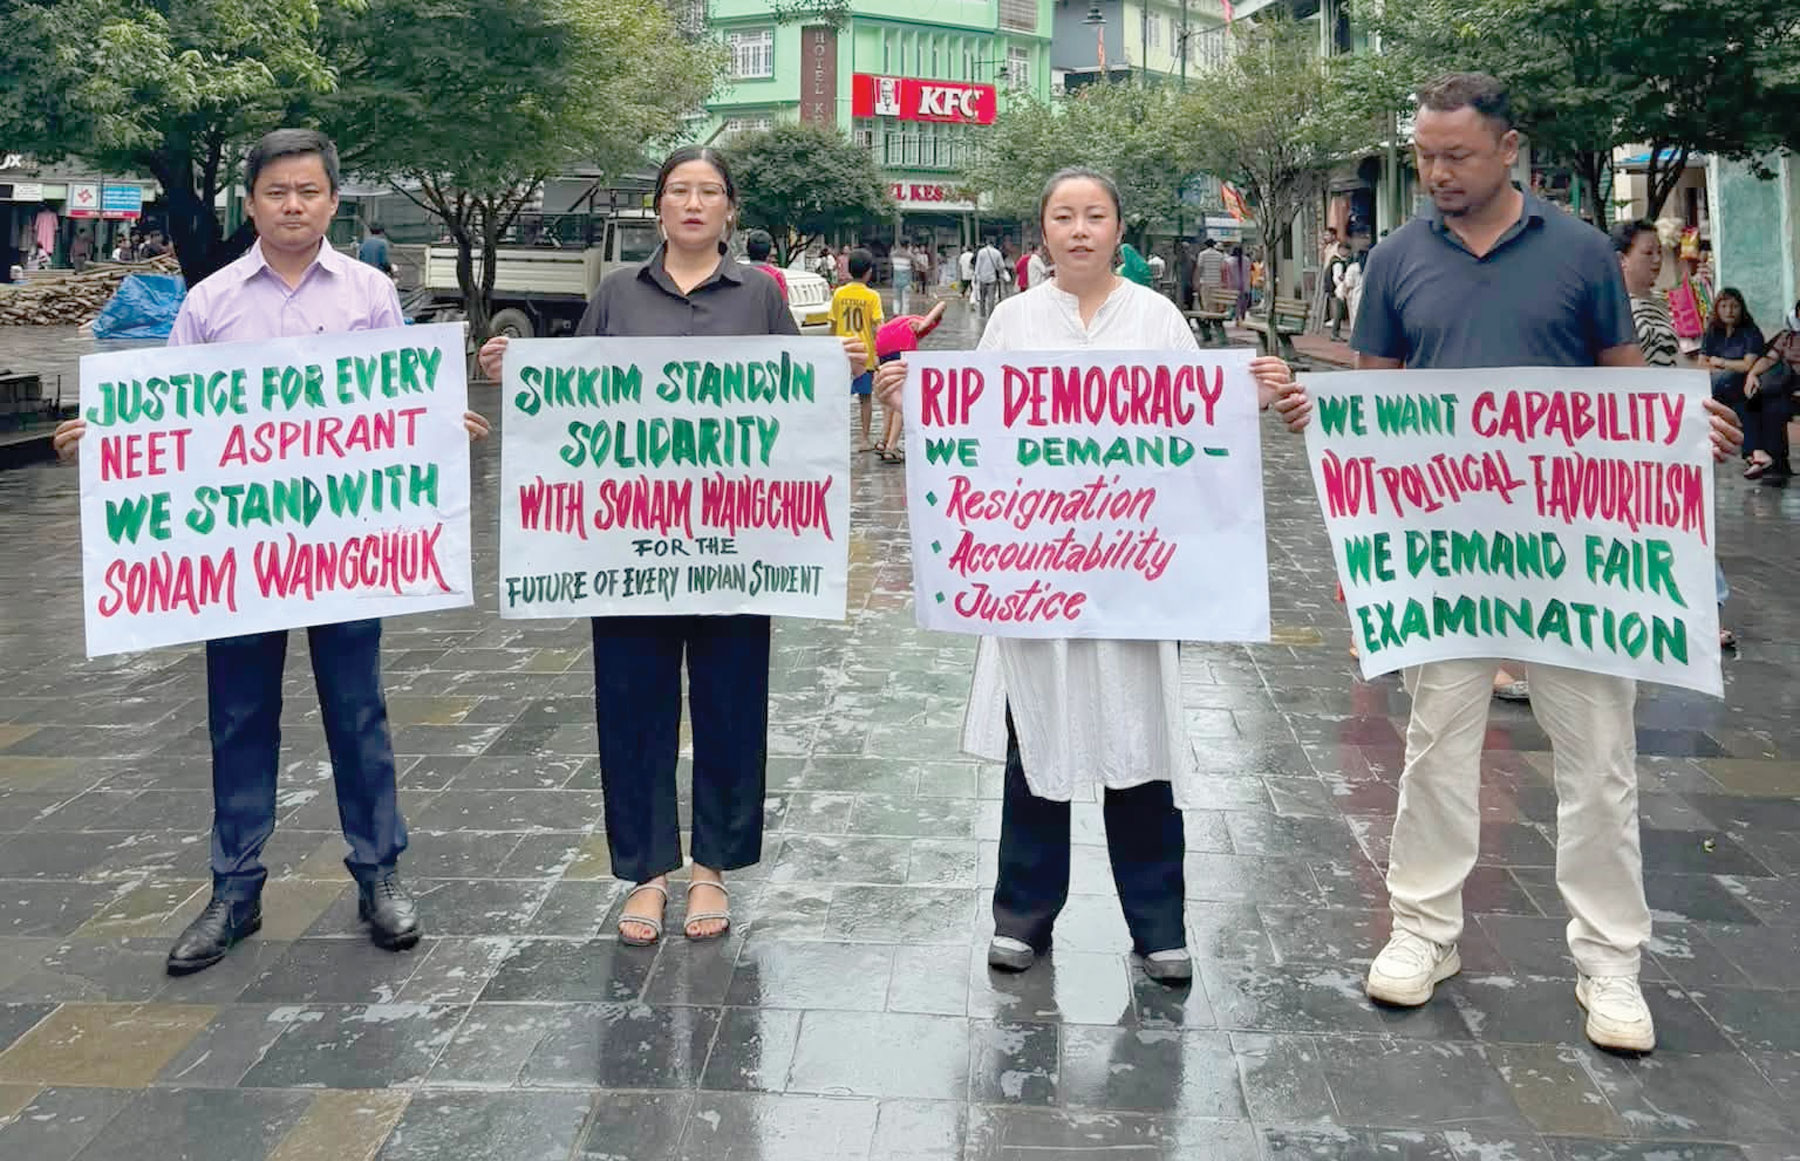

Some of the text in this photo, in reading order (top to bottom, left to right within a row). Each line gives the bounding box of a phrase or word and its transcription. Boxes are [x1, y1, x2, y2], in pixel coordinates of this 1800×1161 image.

[814, 32, 825, 95] HOTEL
[918, 86, 984, 118] KFC
[843, 306, 863, 332] 10
[86, 346, 443, 427] JUSTICE FOR EVERY
[515, 363, 643, 416] SIKKIM
[921, 364, 1224, 428] RIP DEMOCRACY
[101, 407, 427, 481] NEET ASPIRANT
[560, 415, 780, 468] SOLIDARITY
[1317, 390, 1686, 447] WE WANT CAPABILITY
[925, 437, 980, 467] WE
[105, 492, 172, 545] WE
[518, 472, 834, 541] WITH SONAM WANGCHUK
[946, 474, 1156, 530] Resignation
[1322, 449, 1708, 546] NOT POLITICAL FAVOURITISM
[99, 522, 451, 618] SONAM WANGCHUK
[631, 537, 738, 556] FOR THE
[948, 527, 1178, 580] Accountability
[1344, 529, 1688, 608] WE DEMAND FAIR
[506, 560, 824, 607] FUTURE OF EVERY INDIAN STUDENT
[954, 580, 1088, 623] Justice
[1356, 593, 1688, 666] EXAMINATION
